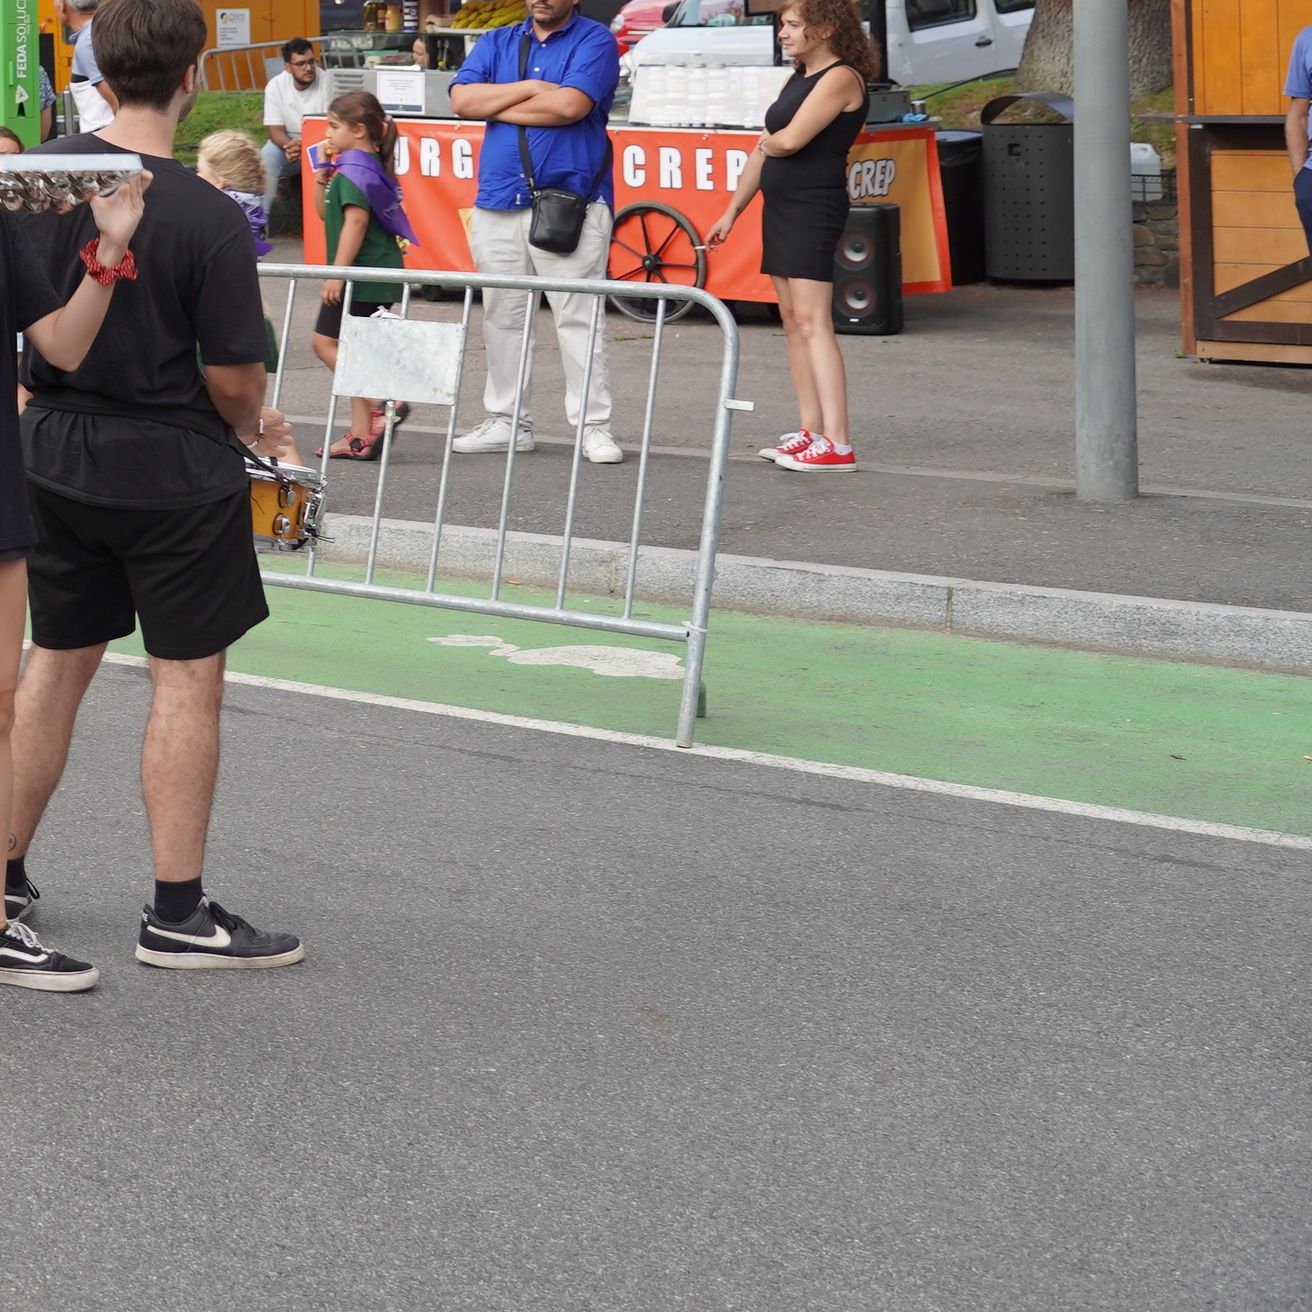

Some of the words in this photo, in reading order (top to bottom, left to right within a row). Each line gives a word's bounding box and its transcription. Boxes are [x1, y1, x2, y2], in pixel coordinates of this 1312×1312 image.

[16, 44, 28, 79] FEDA
[622, 144, 749, 192] CREP
[849, 158, 896, 201] CREP
